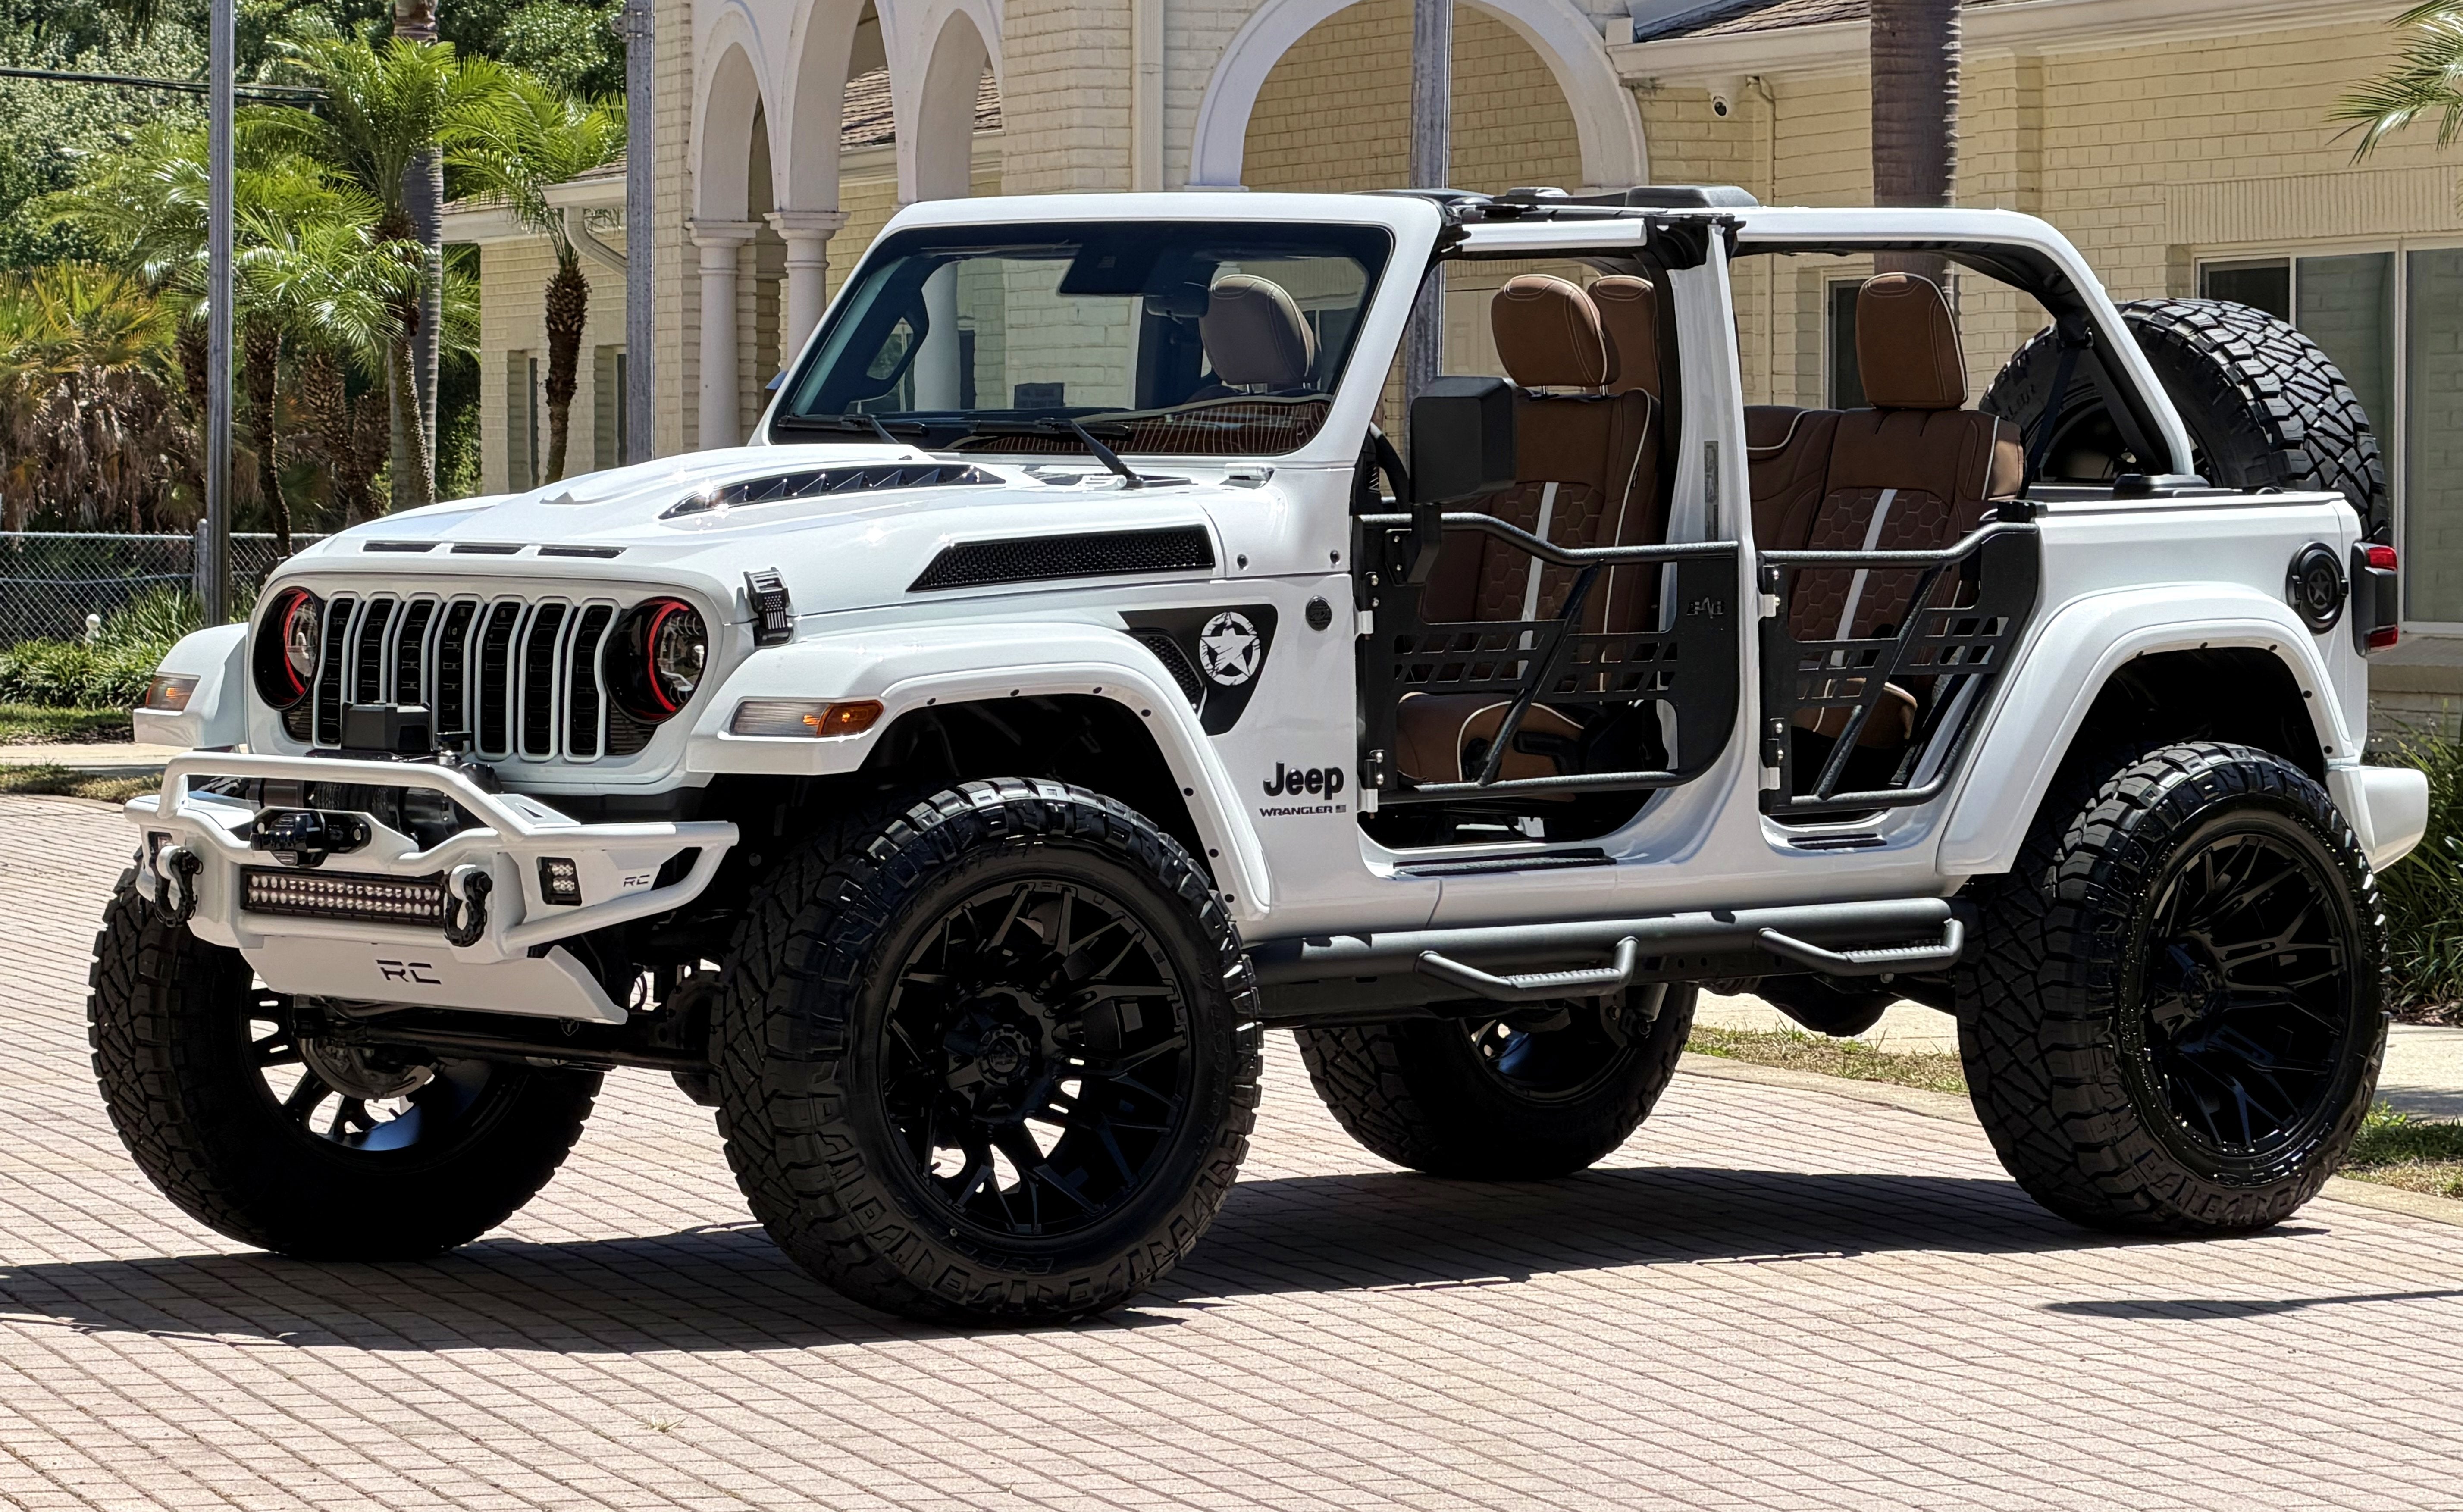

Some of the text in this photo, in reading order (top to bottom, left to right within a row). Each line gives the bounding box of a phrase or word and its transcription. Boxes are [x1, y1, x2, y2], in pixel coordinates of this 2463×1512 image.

[1263, 760, 1344, 800] Jeep
[1259, 805, 1333, 817] WRANGLER
[623, 874, 650, 887] RC
[375, 959, 442, 985] RC
